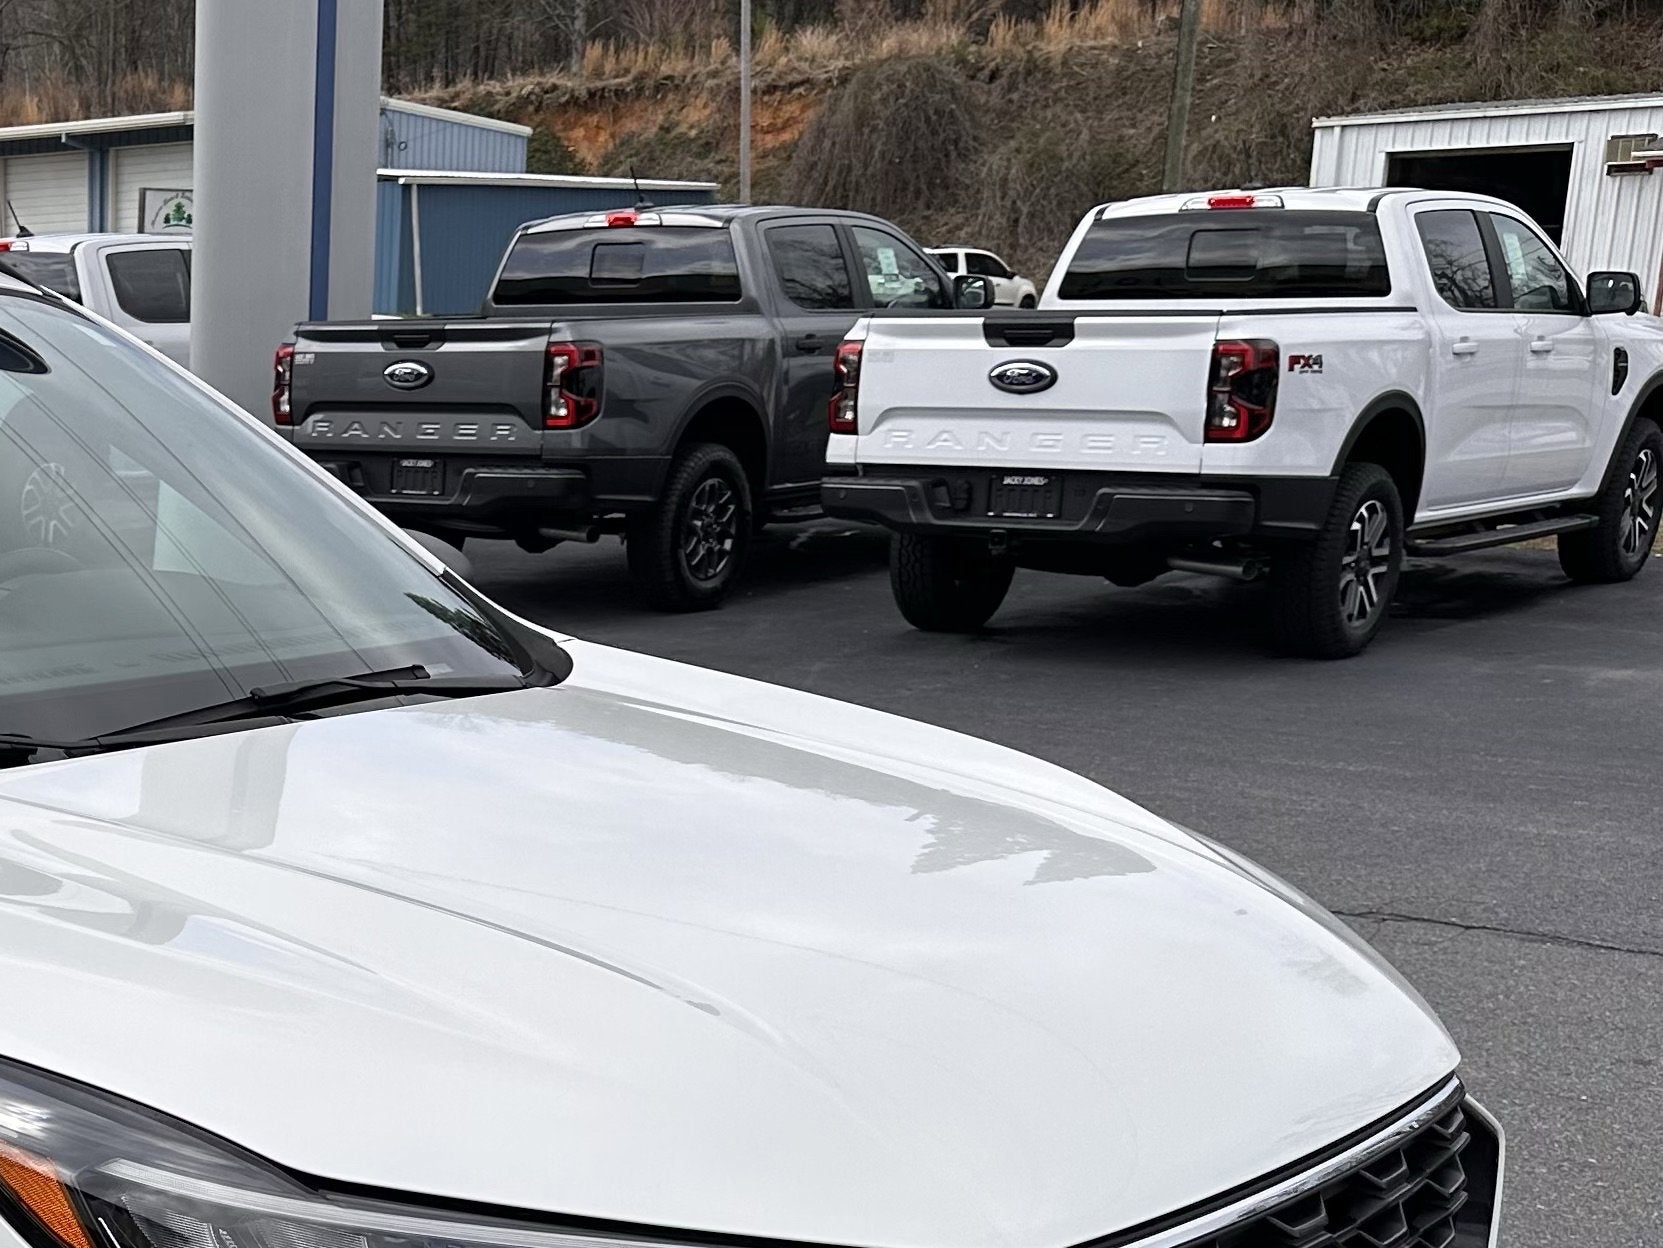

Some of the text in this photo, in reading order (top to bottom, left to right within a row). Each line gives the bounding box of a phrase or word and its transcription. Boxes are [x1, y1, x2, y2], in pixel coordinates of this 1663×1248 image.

[1288, 354, 1323, 372] FX4
[312, 419, 518, 441] RANGER
[884, 428, 1168, 455] RANGER
